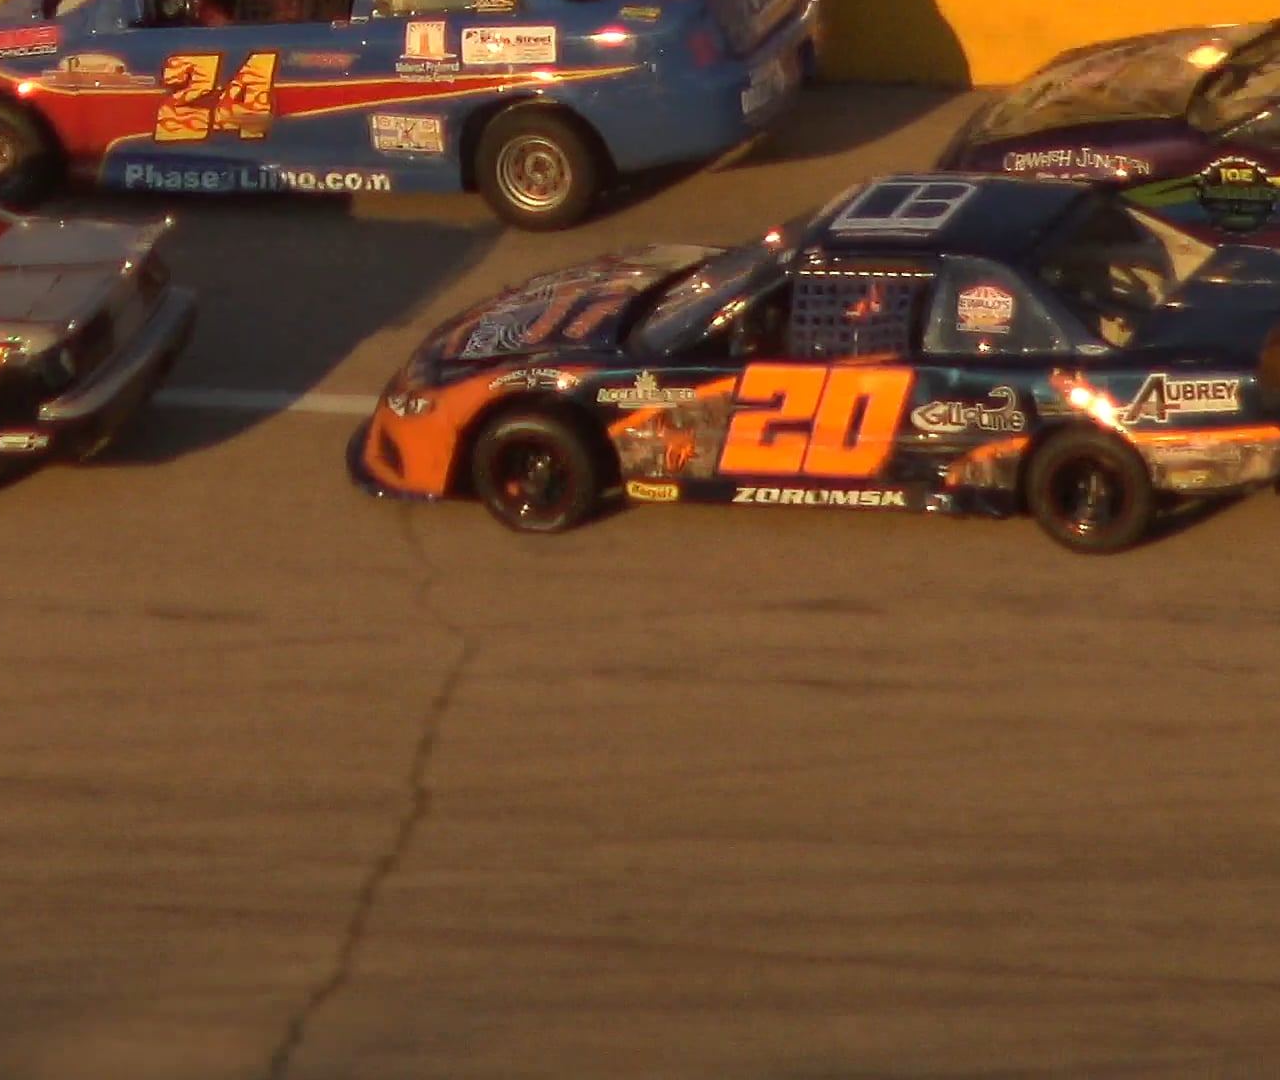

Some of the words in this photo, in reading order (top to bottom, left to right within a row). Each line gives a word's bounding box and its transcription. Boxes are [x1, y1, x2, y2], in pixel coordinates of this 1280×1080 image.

[154, 49, 282, 142] 24
[719, 362, 916, 478] 20
[1122, 373, 1239, 423] AUBREY
